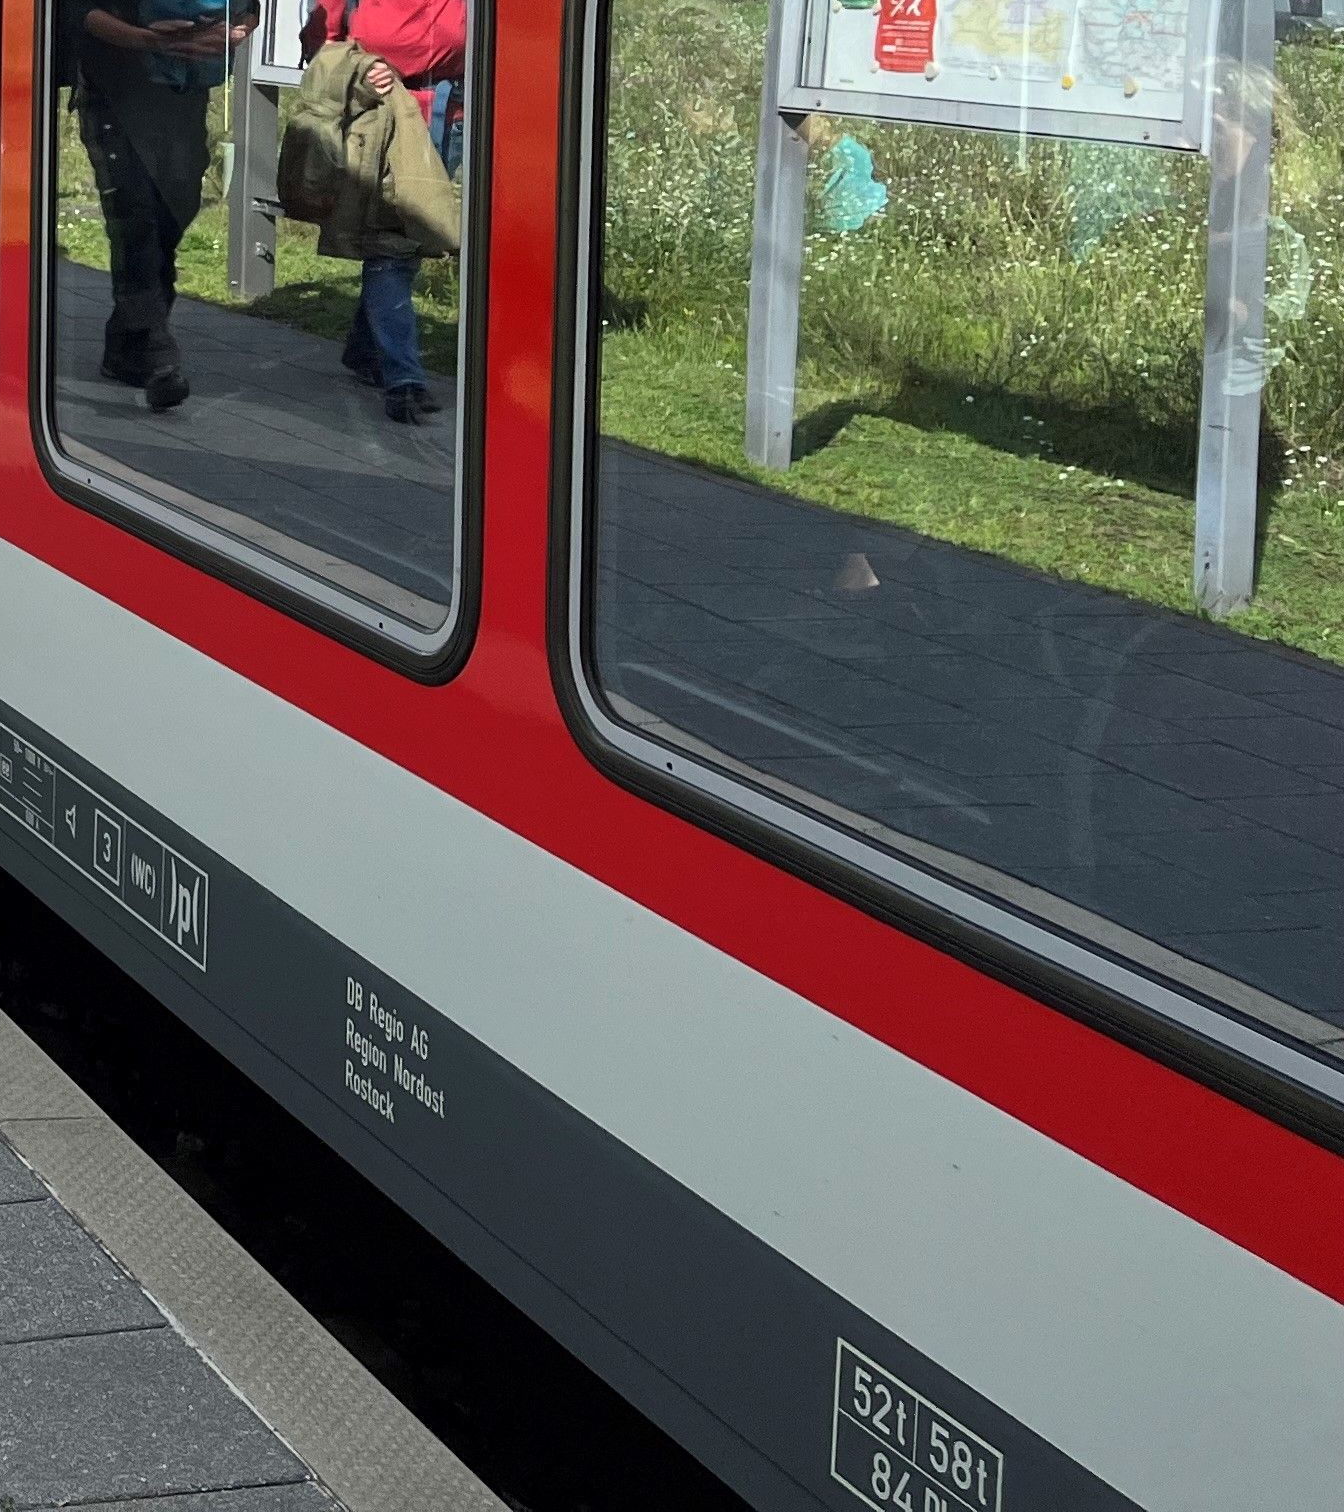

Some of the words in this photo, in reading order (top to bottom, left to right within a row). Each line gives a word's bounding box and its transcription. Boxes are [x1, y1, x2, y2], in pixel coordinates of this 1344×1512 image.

[102, 832, 112, 863] 3
[346, 976, 363, 1012] DB
[369, 991, 404, 1042] Regio
[410, 1024, 430, 1060] AG
[345, 1059, 395, 1124] Rostock
[346, 1017, 387, 1074] Region
[393, 1053, 445, 1119] Nordost
[853, 1365, 907, 1447] 52t
[929, 1420, 988, 1507] 58t
[871, 1451, 914, 1512] 84
